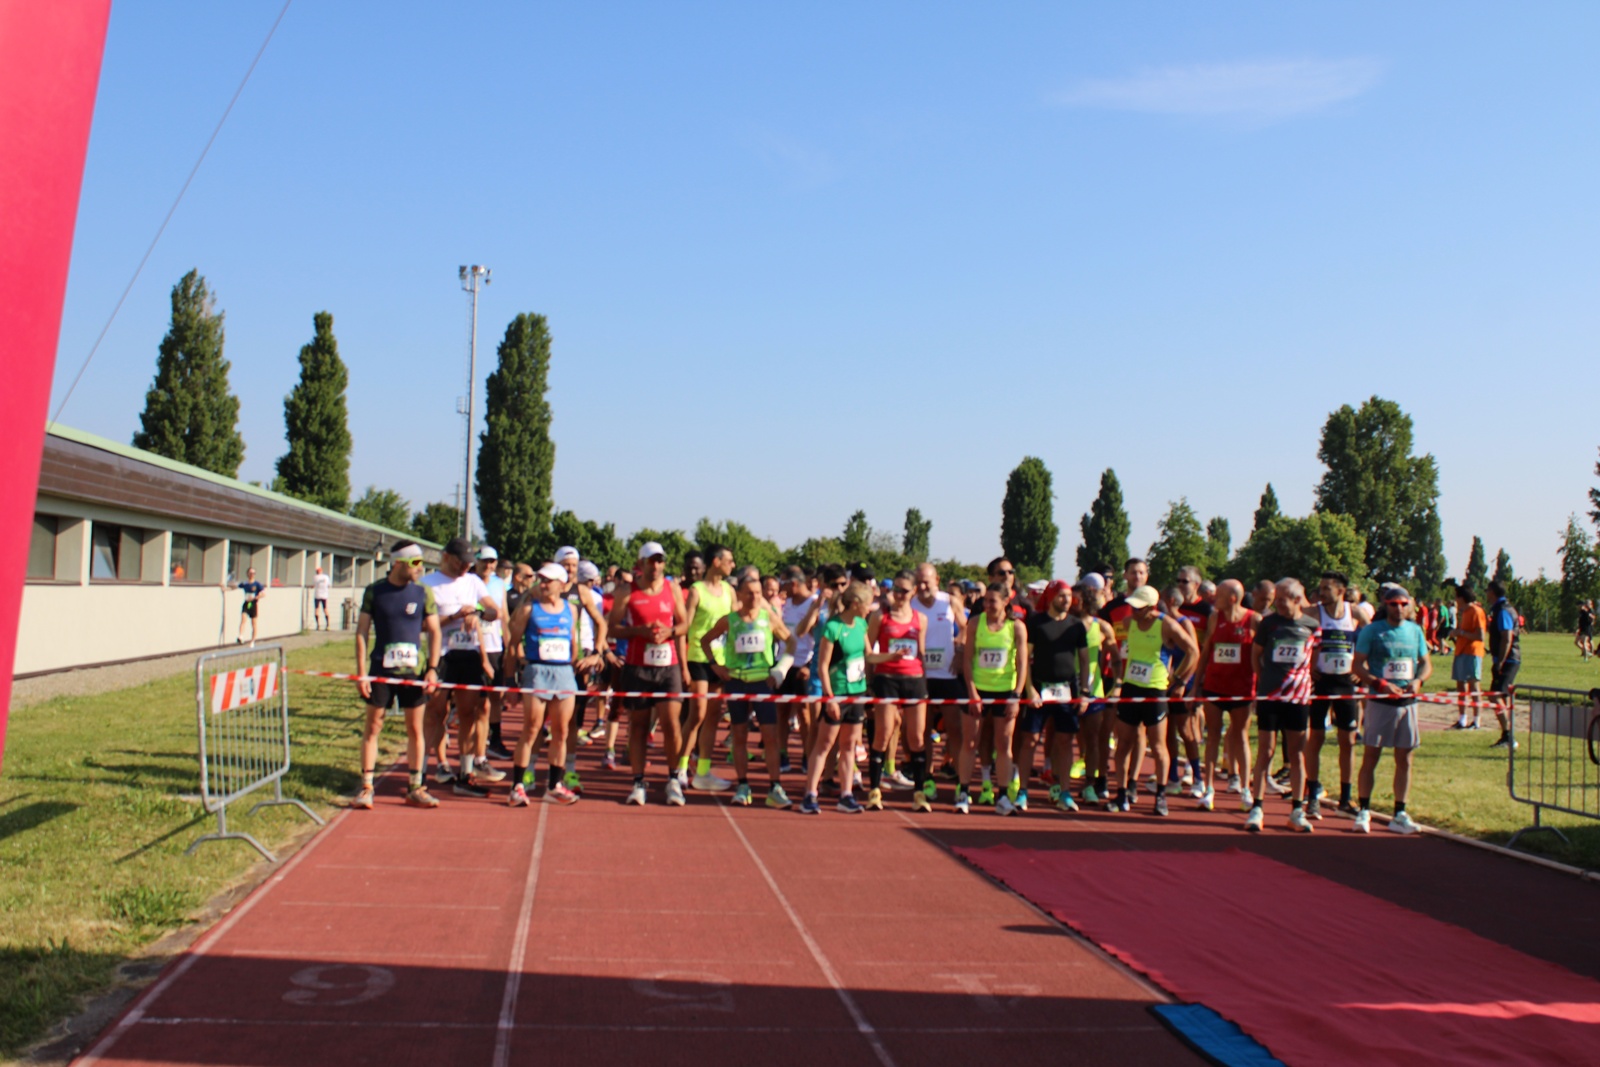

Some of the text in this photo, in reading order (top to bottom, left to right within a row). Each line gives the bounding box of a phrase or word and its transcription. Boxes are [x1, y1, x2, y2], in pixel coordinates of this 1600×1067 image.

[741, 636, 759, 646] 141
[545, 643, 564, 653] 299
[1218, 648, 1236, 658] 248
[1278, 646, 1298, 657] 272
[390, 650, 410, 660] 194
[650, 649, 668, 659] 122
[925, 653, 942, 663] 192
[983, 653, 1002, 663] 173
[1333, 658, 1345, 668] 14
[1388, 662, 1407, 672] 303
[1130, 665, 1148, 676] 234
